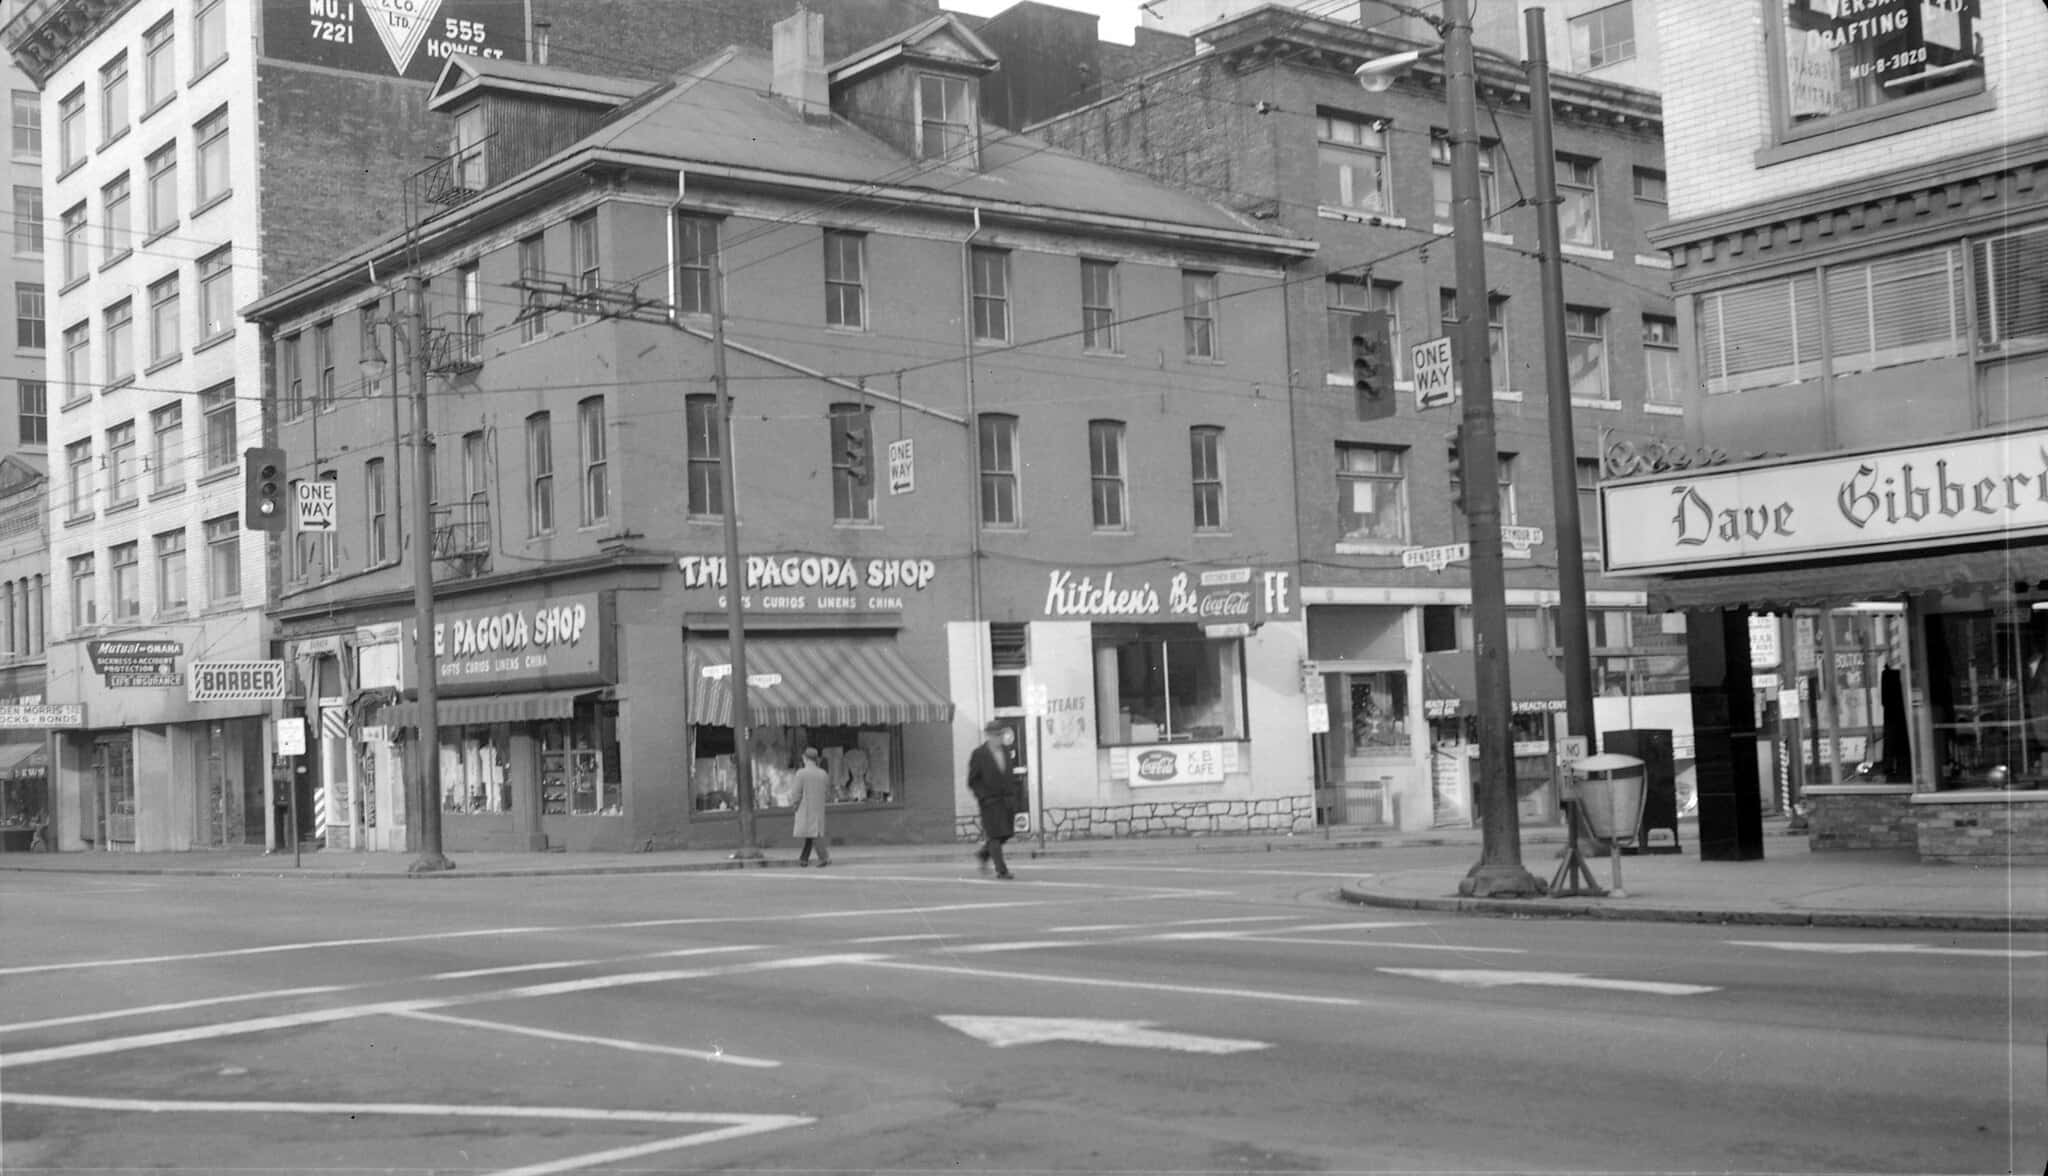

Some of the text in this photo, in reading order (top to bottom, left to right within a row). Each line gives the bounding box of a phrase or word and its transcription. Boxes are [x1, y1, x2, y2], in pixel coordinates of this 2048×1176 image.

[311, 20, 354, 44] 7221
[445, 18, 487, 43] 555
[1806, 9, 1910, 53] DRAFTING
[1415, 343, 1449, 369] ONE
[1417, 365, 1450, 391] WAY
[889, 443, 912, 462] ONE
[891, 462, 912, 480] WAY
[300, 484, 333, 500] ONE
[301, 502, 334, 517] WAY
[1671, 485, 1796, 546] Dave
[1500, 528, 1530, 541] EYMOUR
[747, 556, 859, 590] PAGODA
[867, 559, 936, 590] SHOP
[1044, 568, 1290, 616] Kitchen's Be FE
[763, 596, 805, 609] CURIOS
[817, 596, 857, 609] LINENS
[868, 596, 903, 609] CHINA
[453, 610, 529, 658] PAGODA
[534, 603, 587, 648] SHOP
[97, 642, 140, 654] Mutual
[147, 645, 180, 653] OMAHA
[466, 659, 490, 674] CURIOS
[203, 671, 275, 691] BARBER
[1547, 700, 1567, 710] CENT
[1566, 743, 1580, 757] NO
[1187, 763, 1215, 776] CAFE
